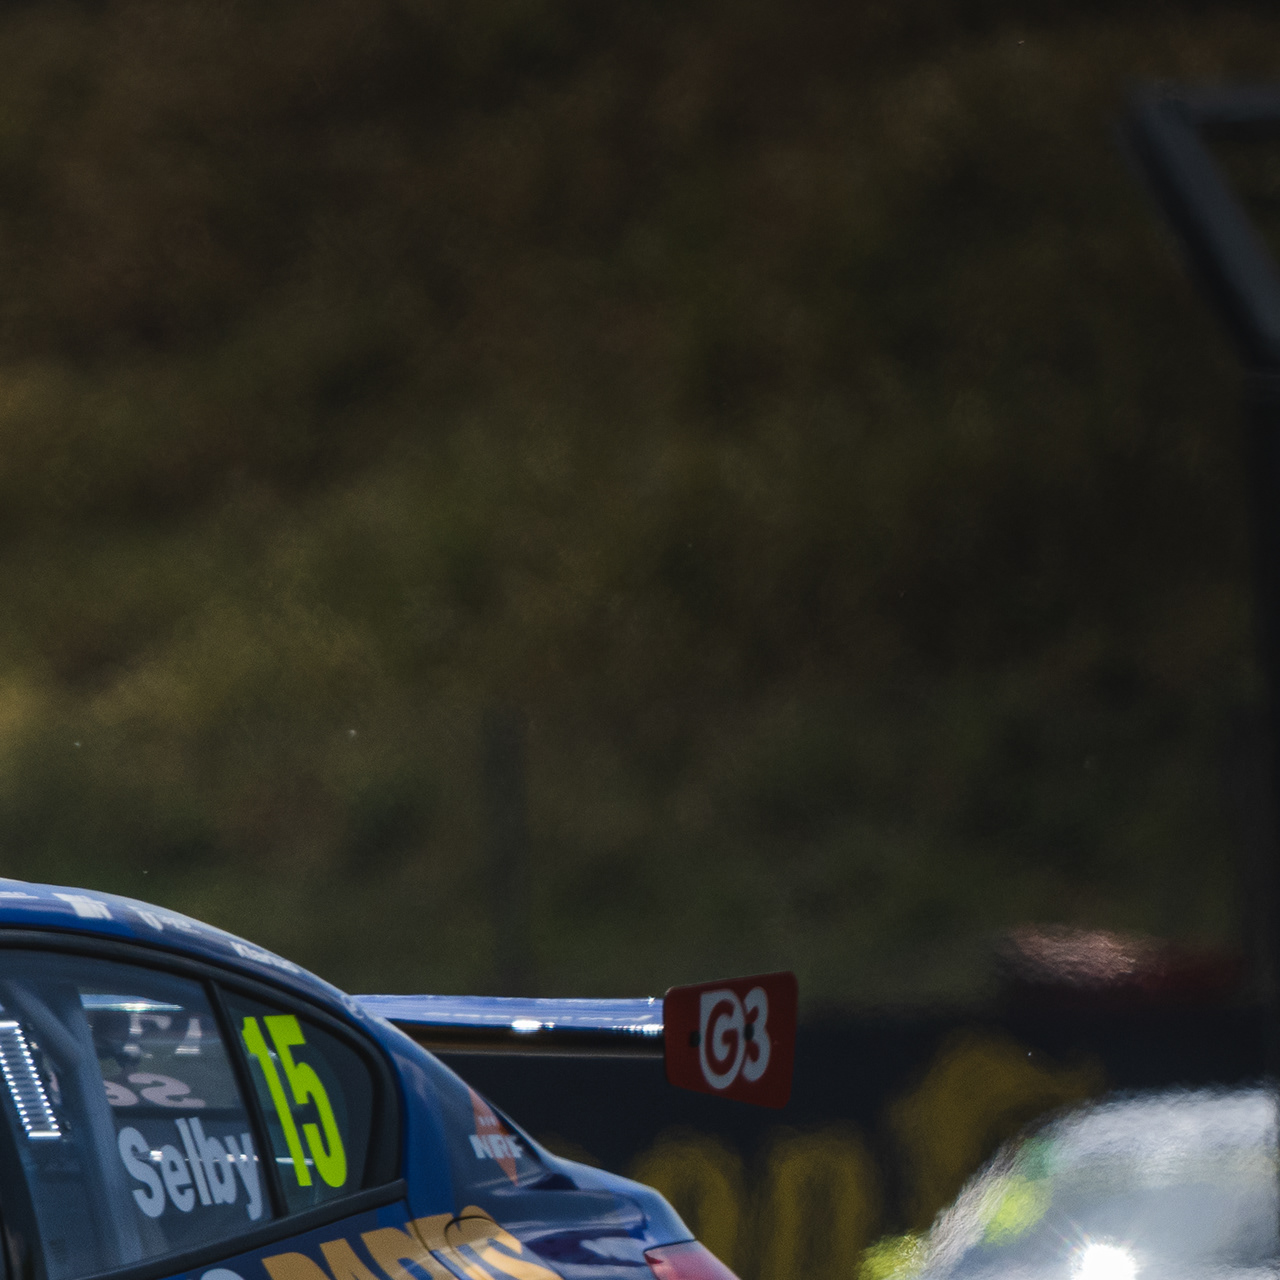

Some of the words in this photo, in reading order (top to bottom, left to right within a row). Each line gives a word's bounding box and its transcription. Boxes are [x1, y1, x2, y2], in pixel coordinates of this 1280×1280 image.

[698, 986, 772, 1090] G3
[242, 1014, 348, 1188] 15
[118, 1118, 263, 1219] Selby
